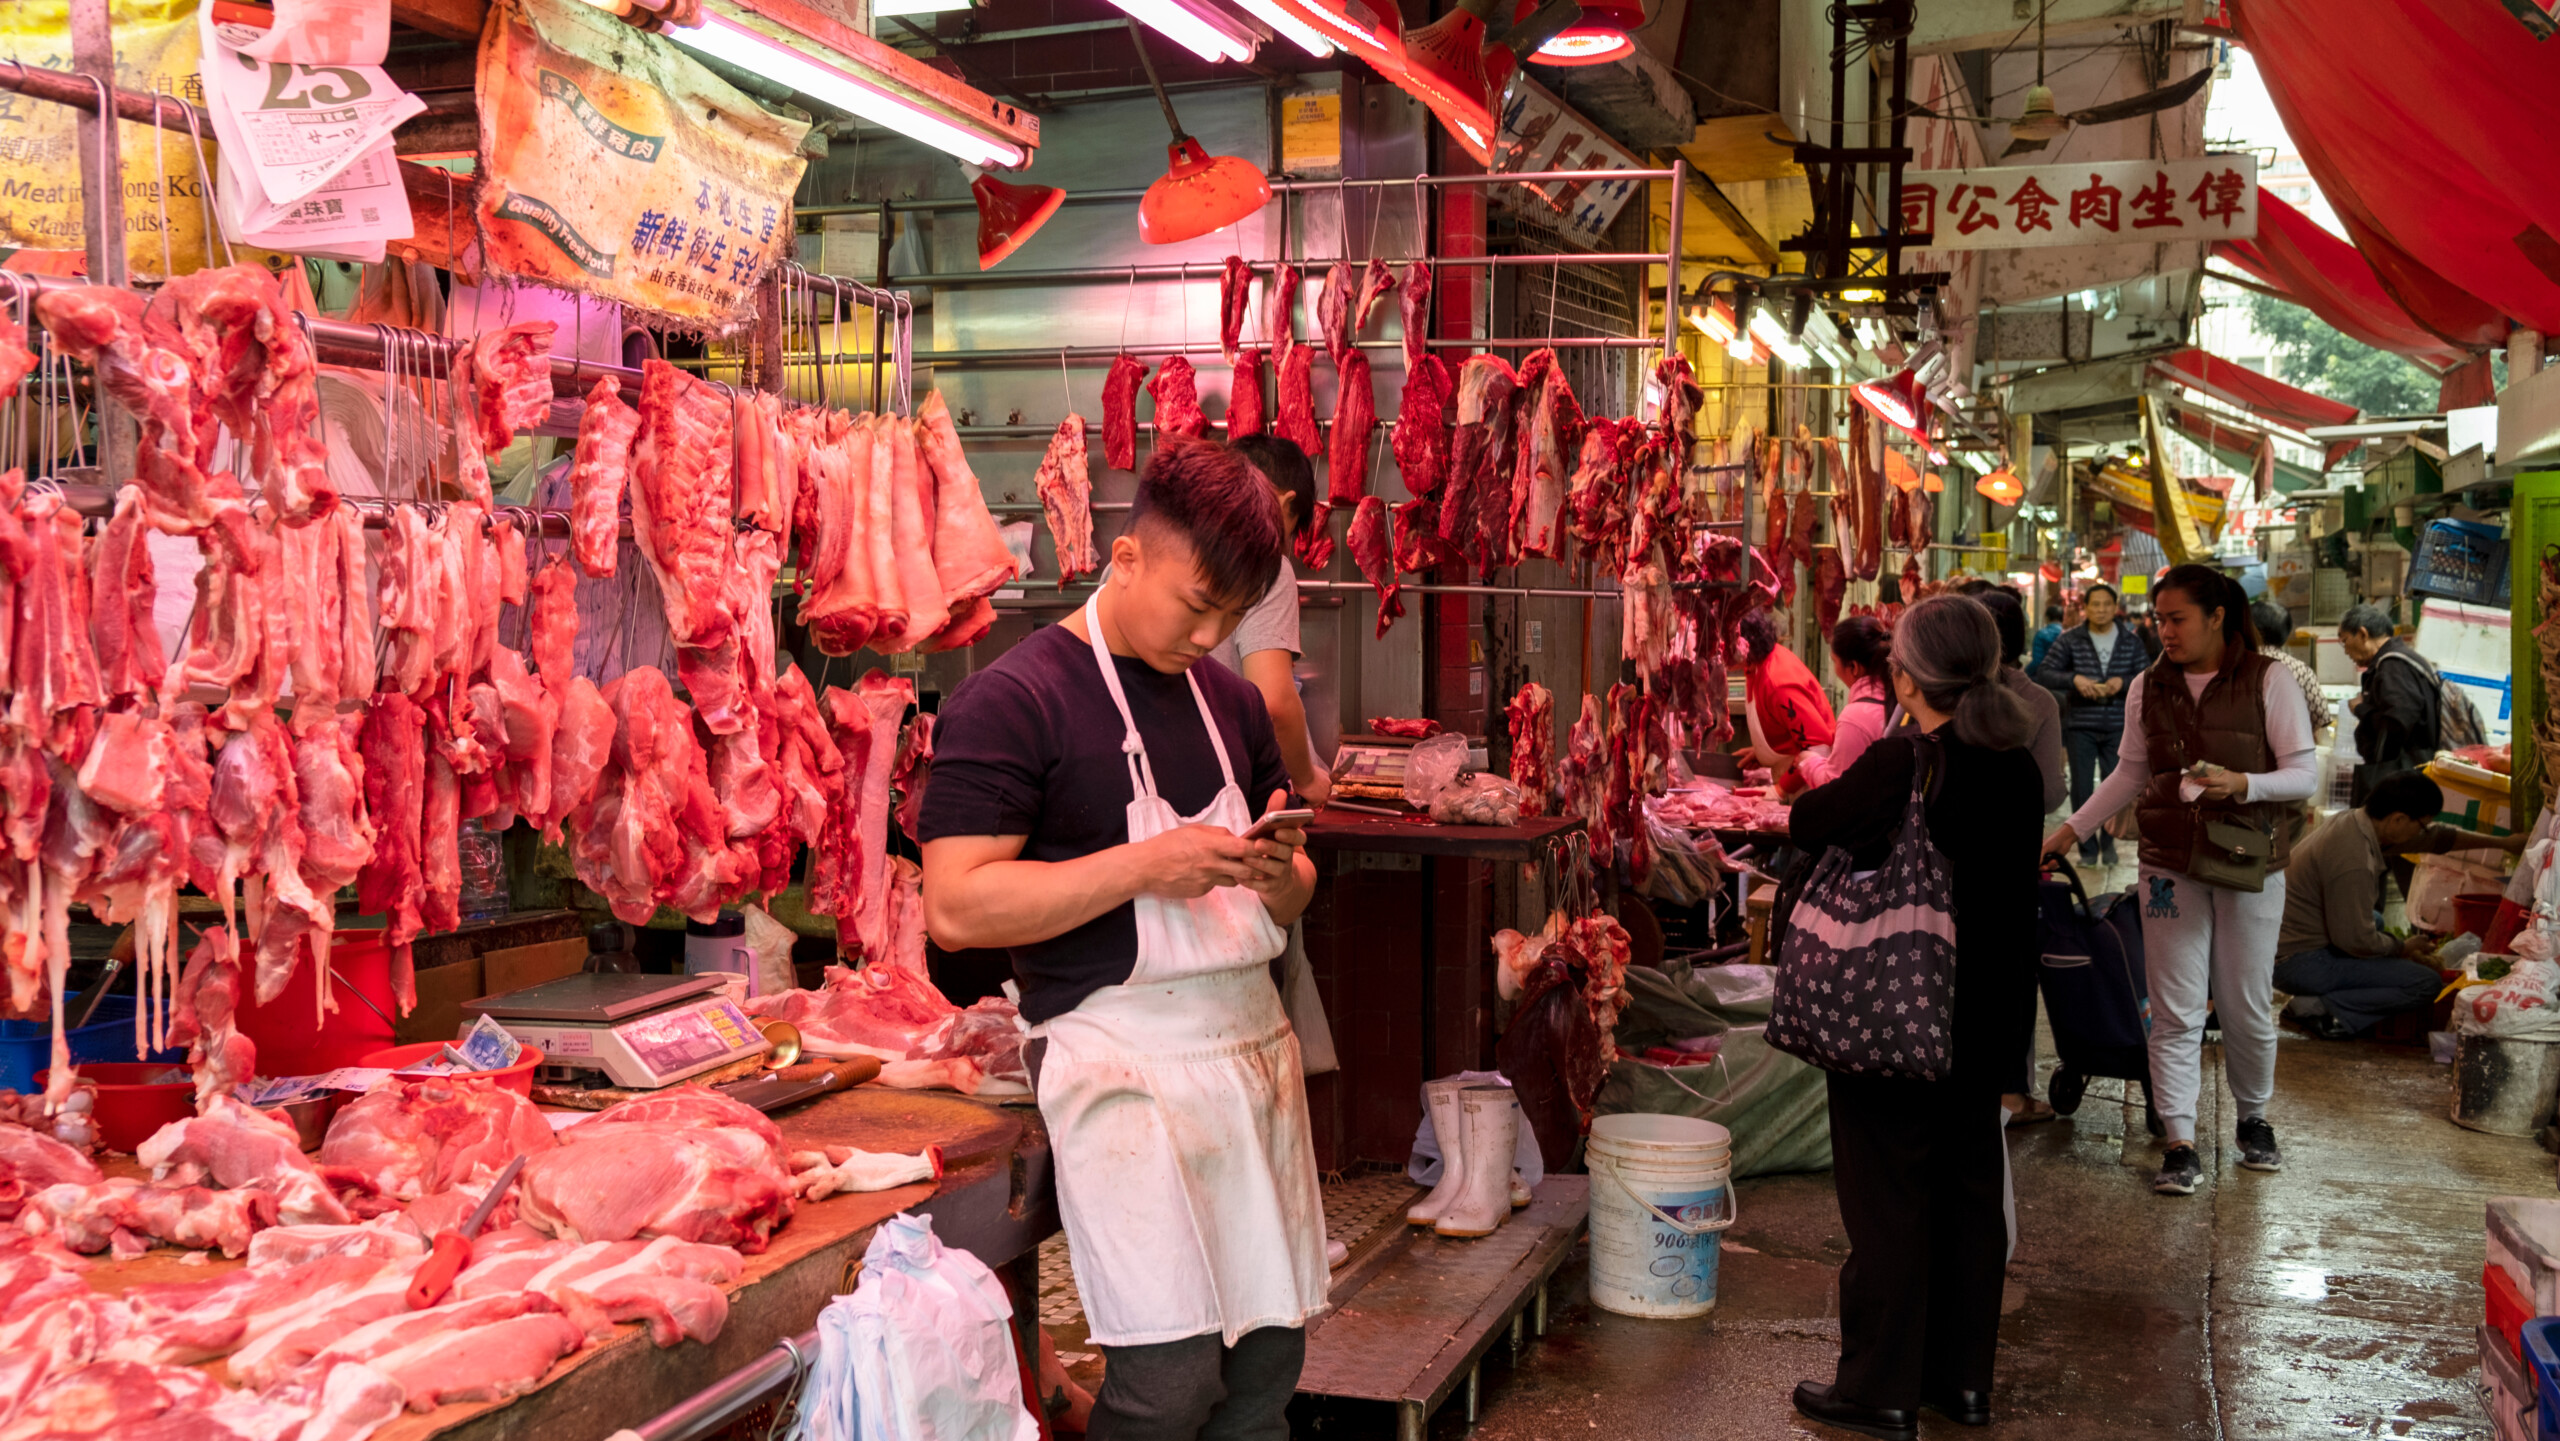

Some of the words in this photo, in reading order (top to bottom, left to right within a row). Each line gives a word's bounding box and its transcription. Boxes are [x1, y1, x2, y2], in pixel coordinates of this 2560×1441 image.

[236, 52, 372, 110] 25
[2, 178, 64, 204] Meat
[507, 199, 562, 235] Quality
[558, 224, 587, 262] Fresh
[2146, 905, 2180, 918] LOVE
